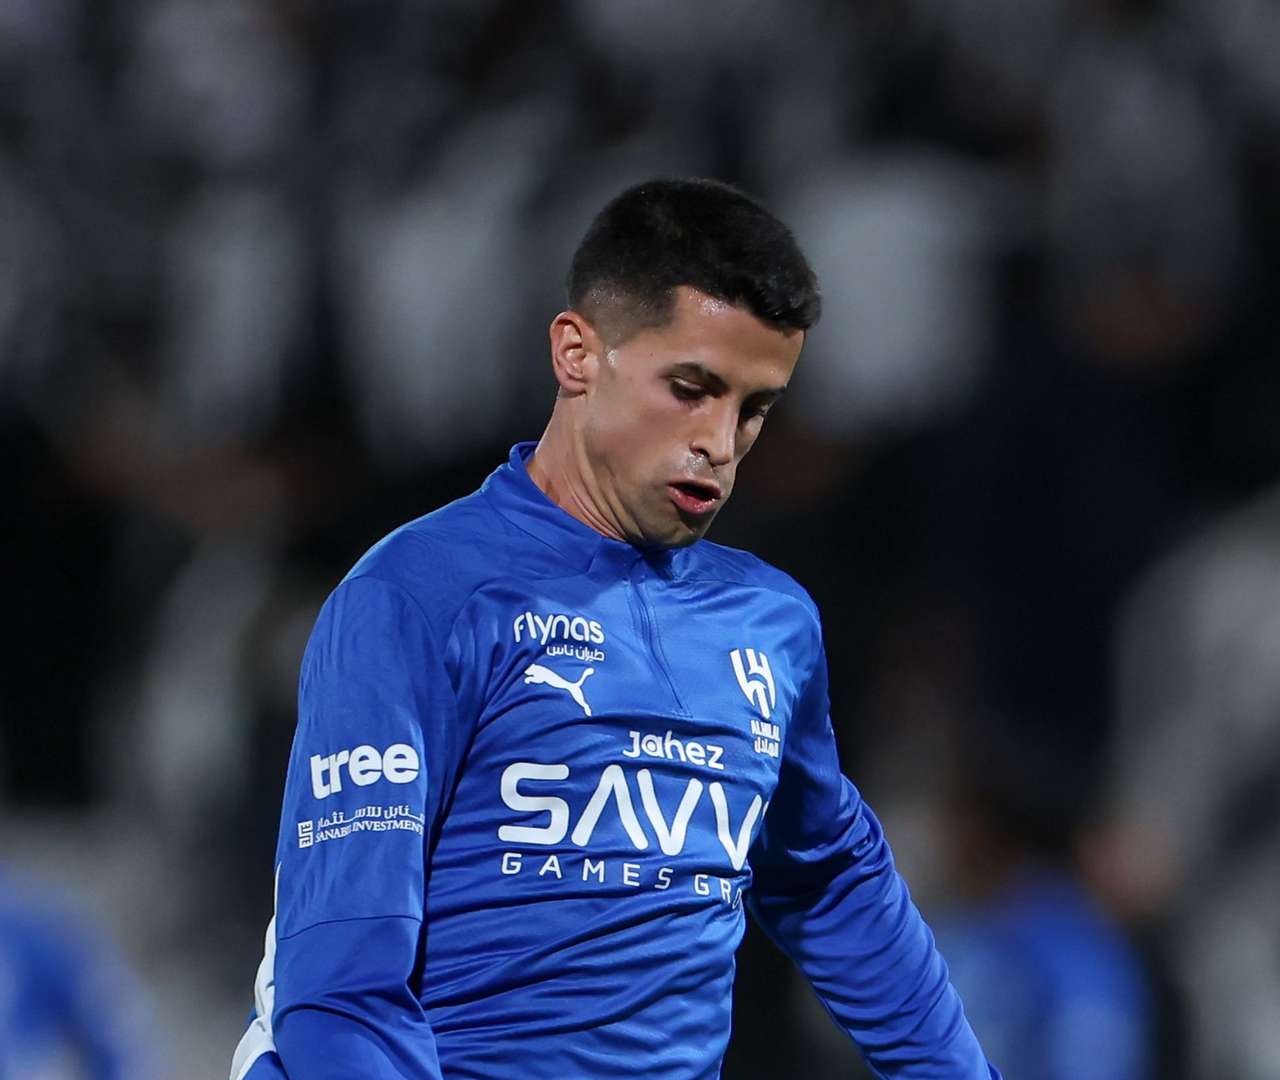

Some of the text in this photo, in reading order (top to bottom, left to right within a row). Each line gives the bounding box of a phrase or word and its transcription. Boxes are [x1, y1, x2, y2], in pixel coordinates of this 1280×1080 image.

[513, 611, 605, 646] flynas
[309, 743, 420, 800] tree
[497, 762, 769, 871] SAVV
[501, 852, 743, 910] GAMES GRO
